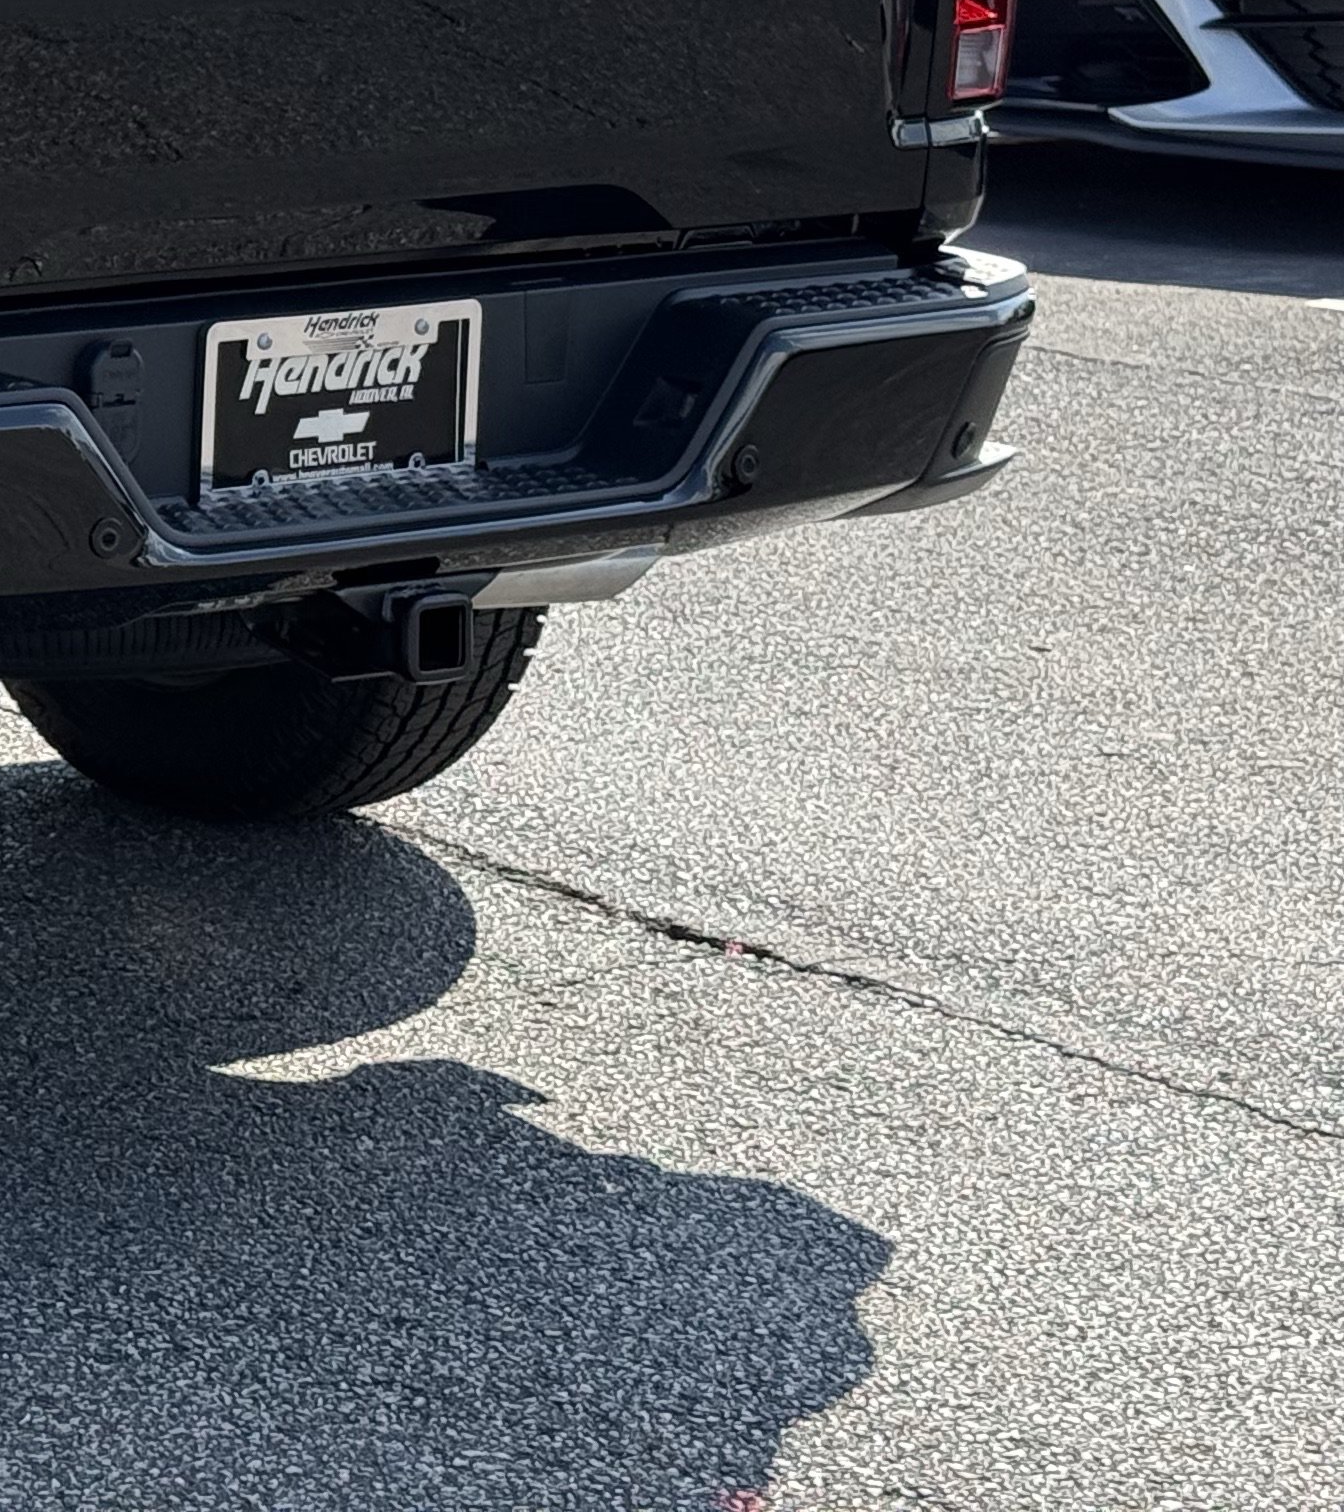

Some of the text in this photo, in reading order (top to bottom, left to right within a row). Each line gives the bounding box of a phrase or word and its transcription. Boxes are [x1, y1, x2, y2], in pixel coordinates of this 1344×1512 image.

[303, 311, 380, 338] Hendrick
[239, 343, 430, 415] Hendrick
[289, 441, 377, 469] CHEVROLET
